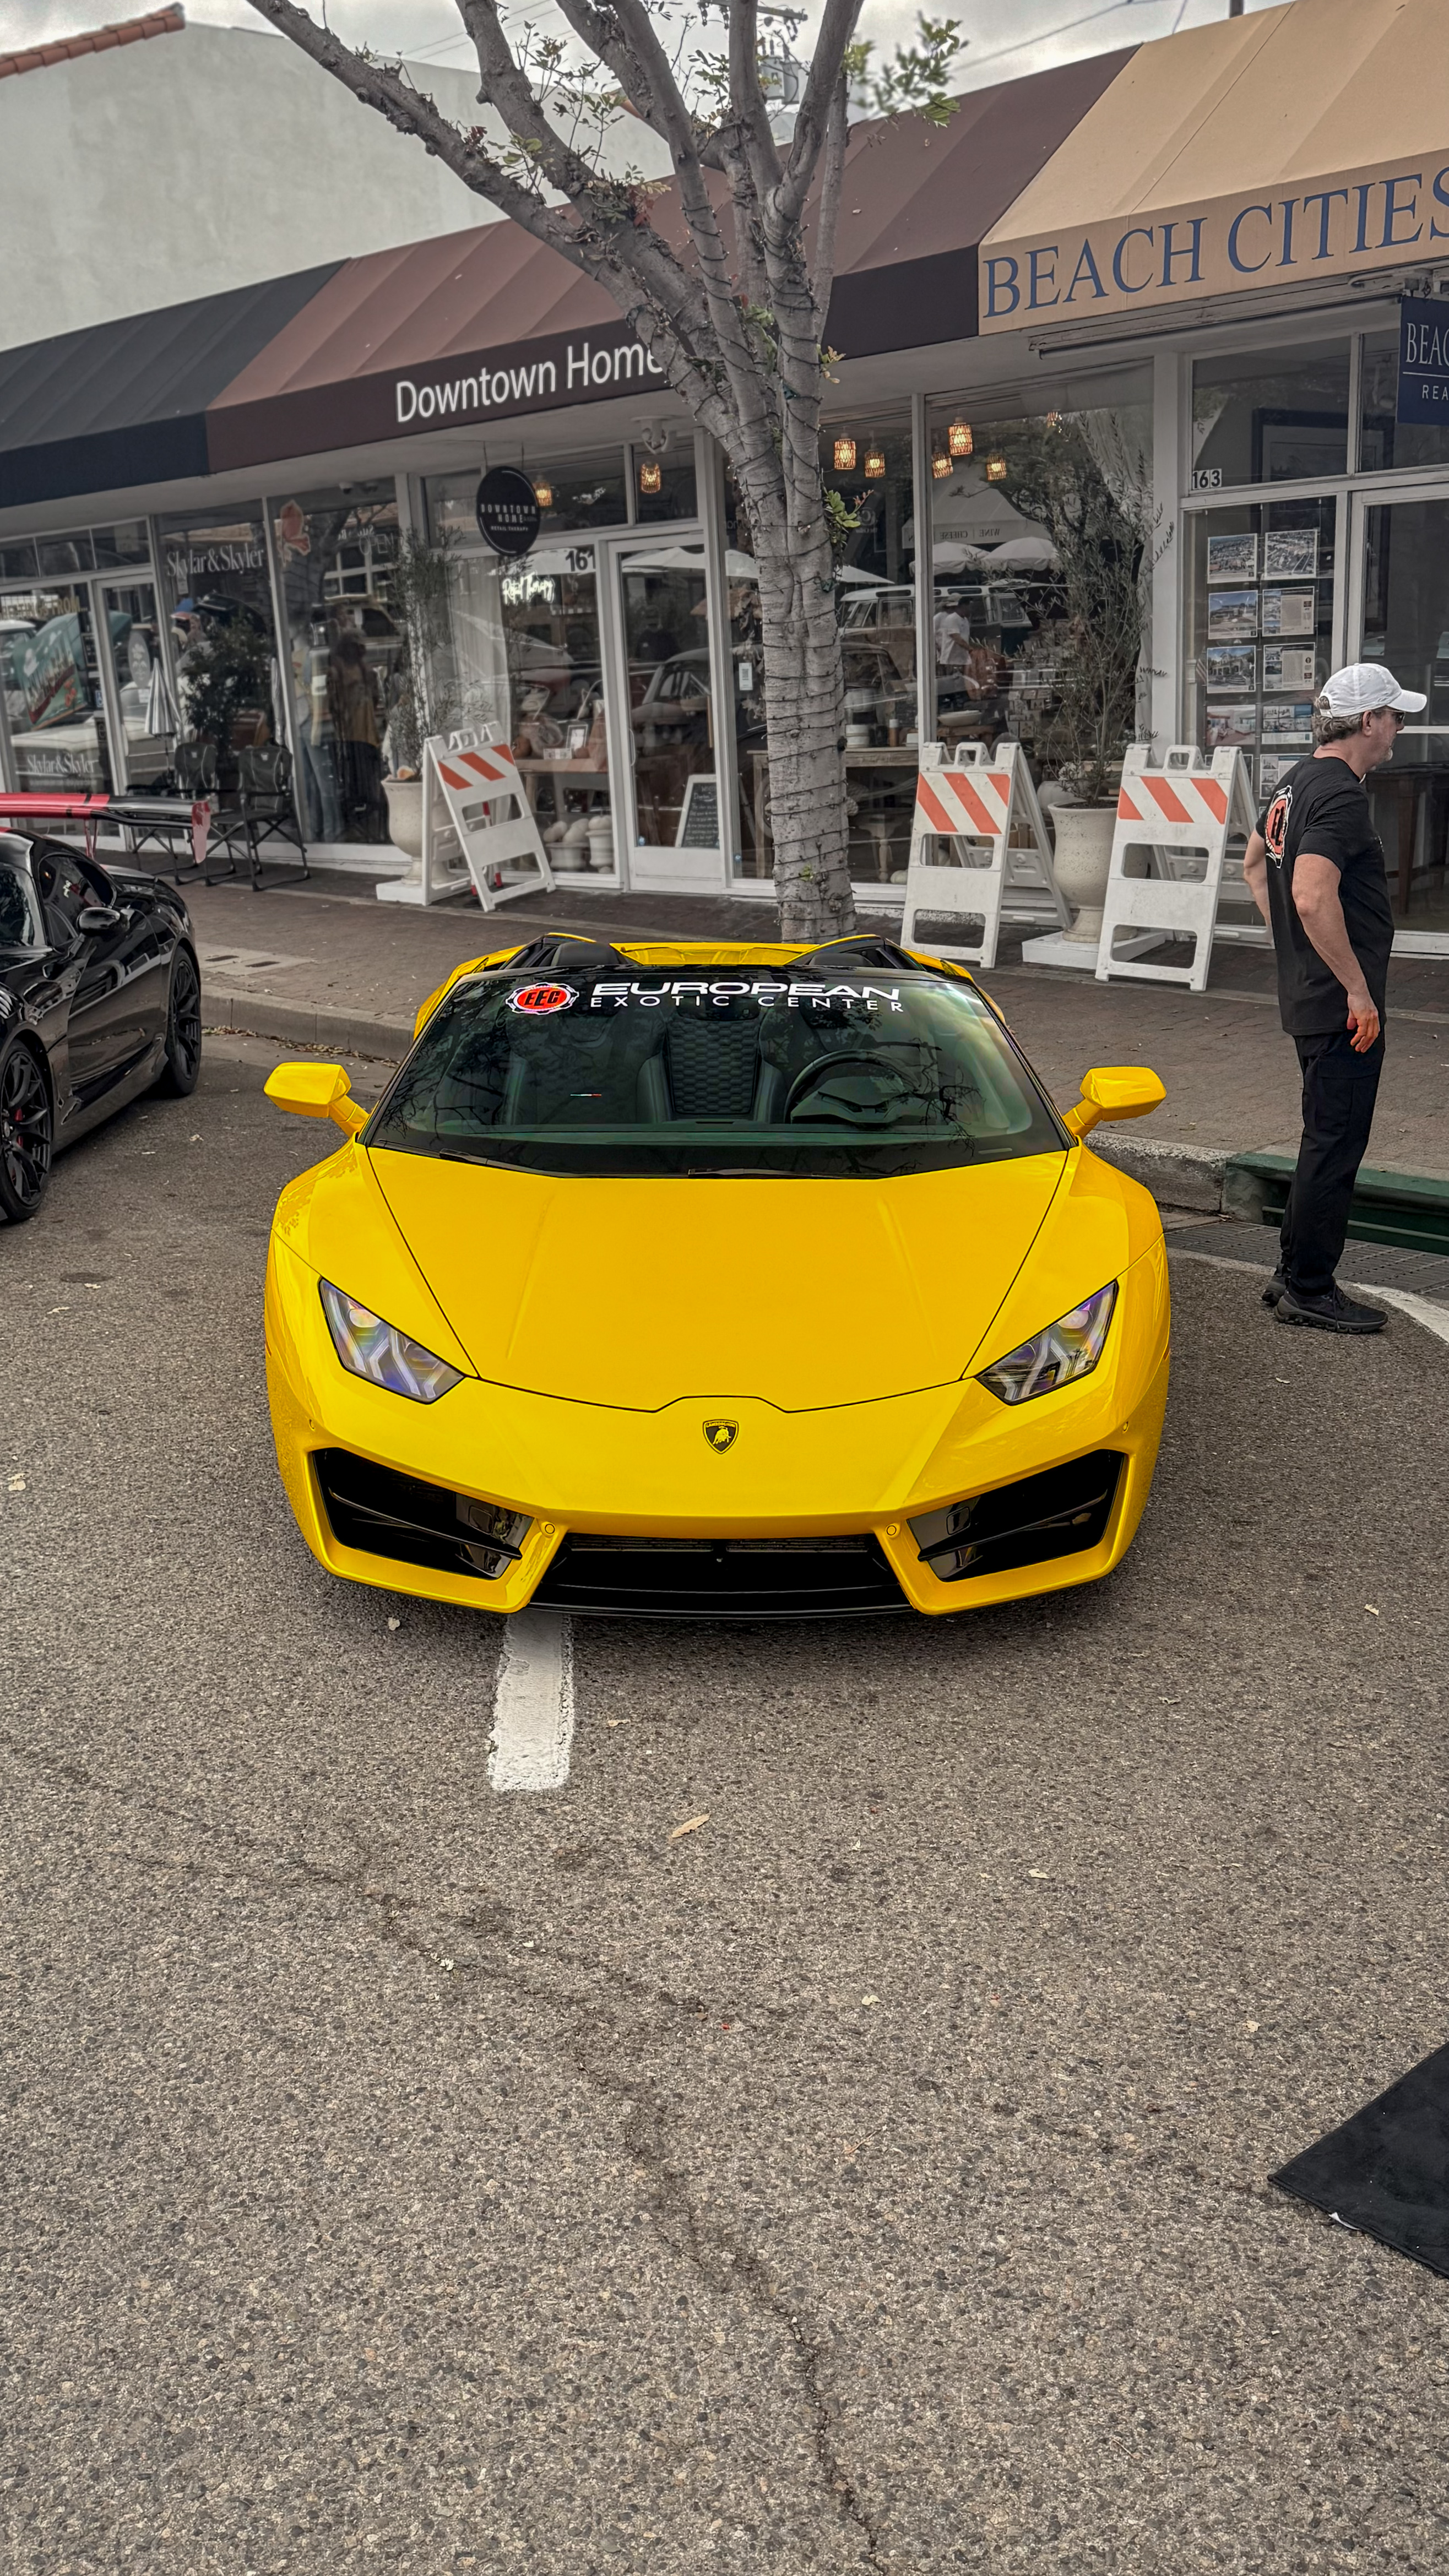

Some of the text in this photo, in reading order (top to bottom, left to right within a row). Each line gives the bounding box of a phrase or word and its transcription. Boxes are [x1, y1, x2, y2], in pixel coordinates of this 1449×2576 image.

[983, 218, 1208, 318] BEACH
[396, 342, 663, 423] Downtown Home
[1192, 470, 1222, 489] 163
[481, 503, 536, 514] DOWNTOWN
[497, 514, 523, 523] HOME
[565, 550, 596, 573] 161
[524, 989, 561, 1007] EEC
[592, 982, 900, 1001] EUROPEAN
[590, 995, 904, 1012] EXOTIC CENTER
